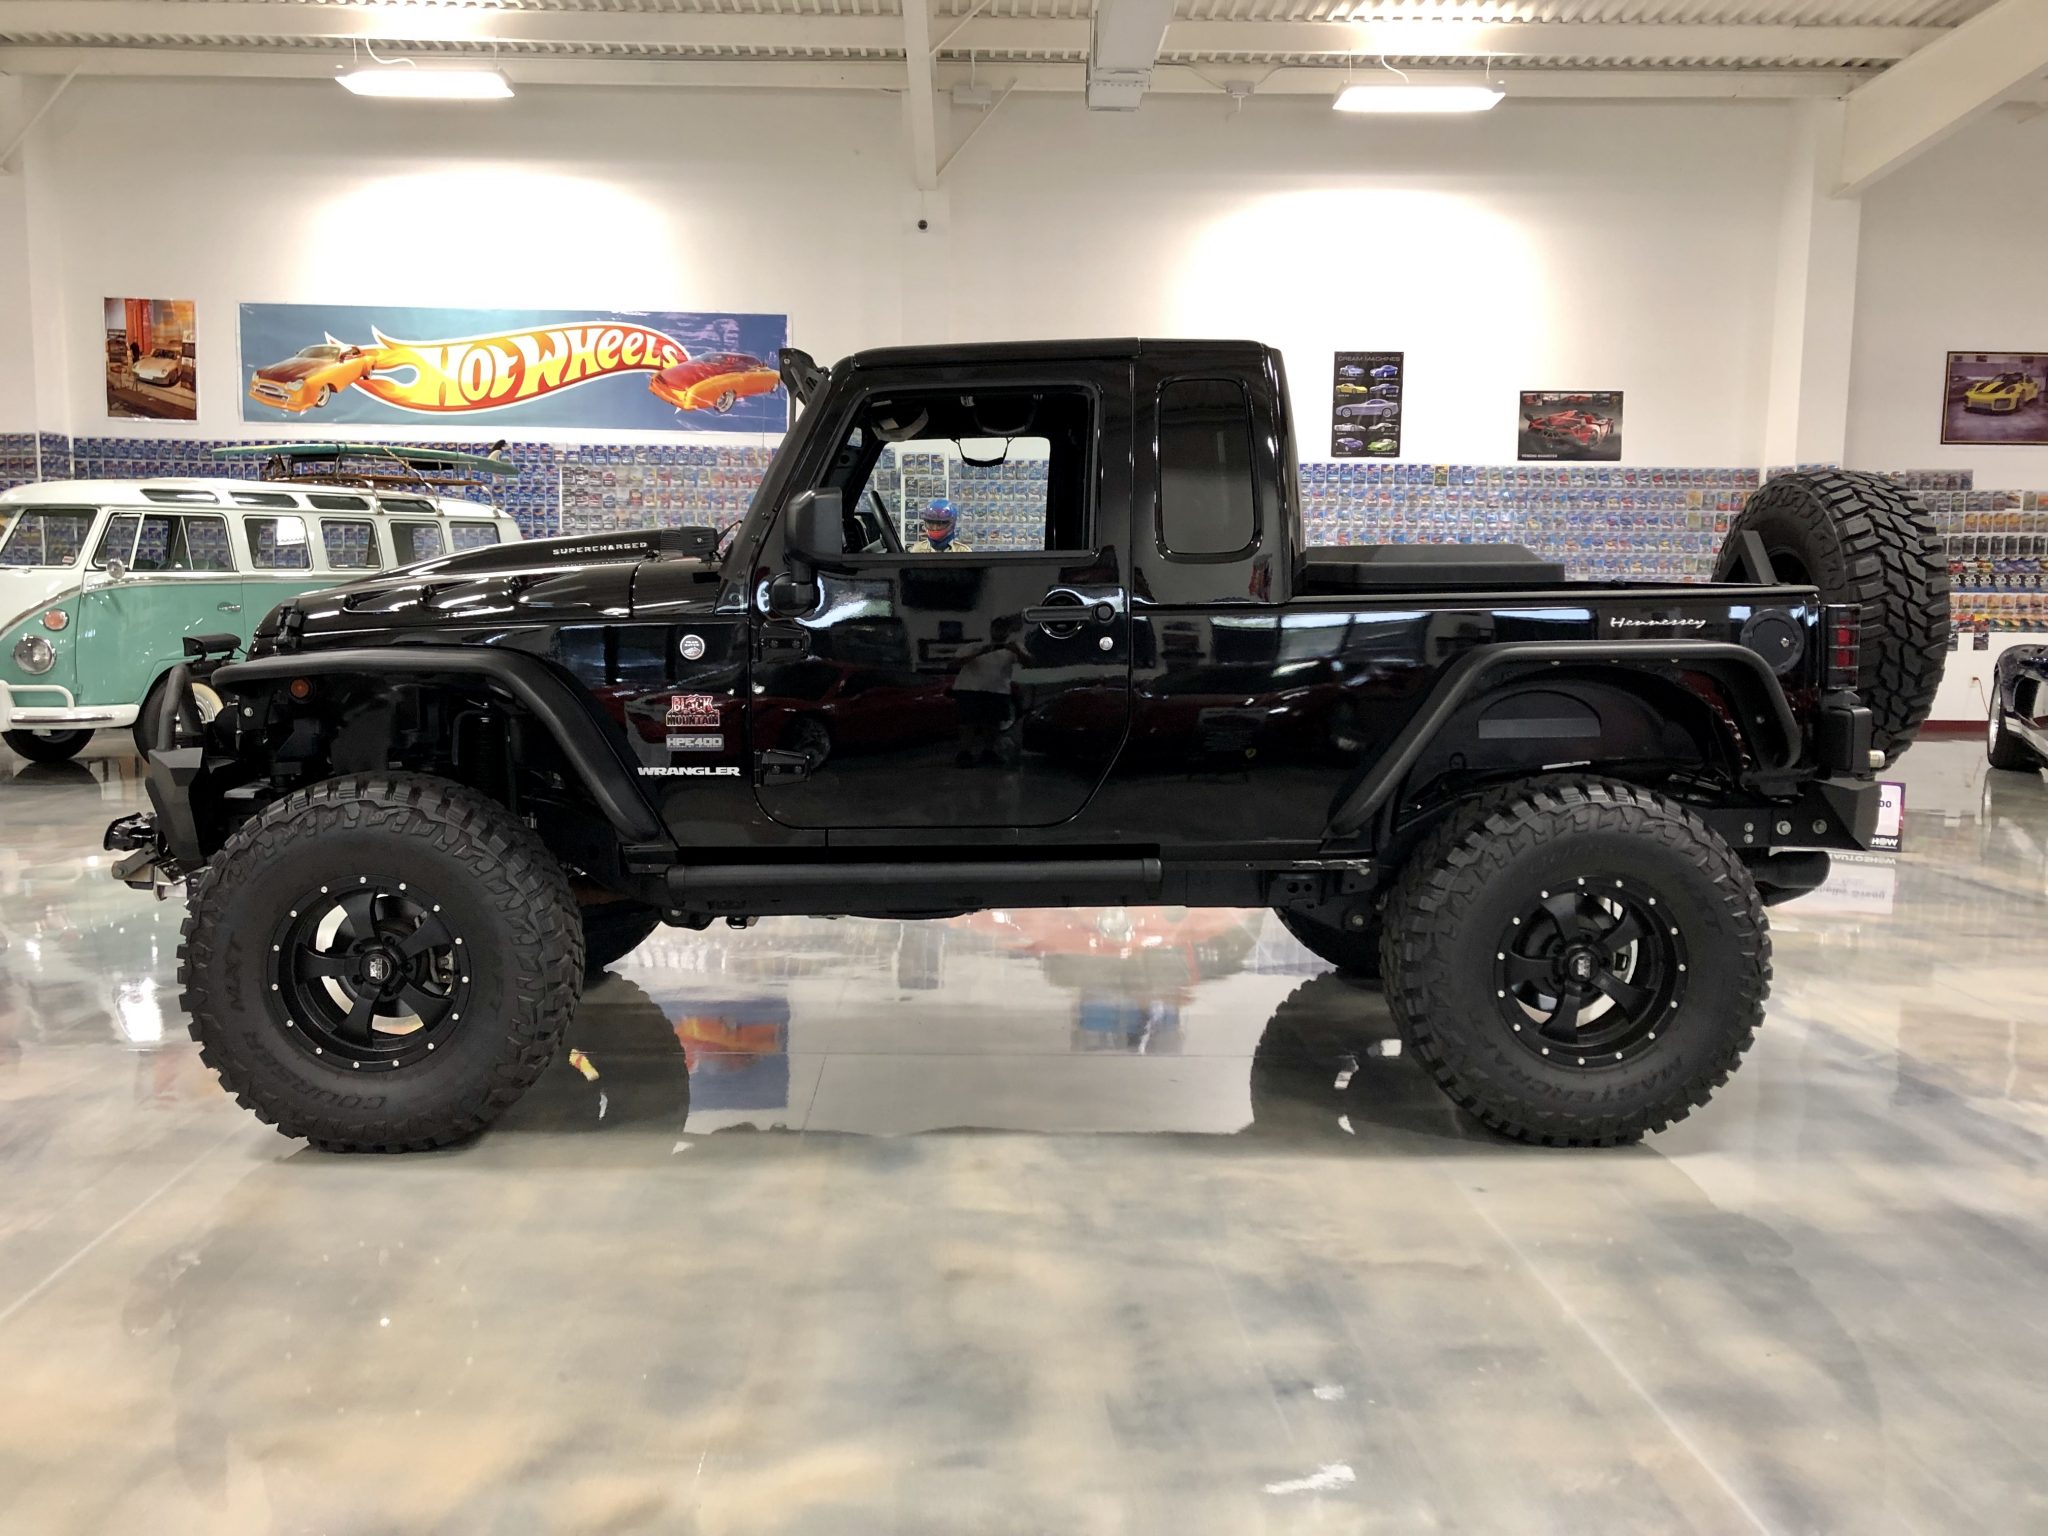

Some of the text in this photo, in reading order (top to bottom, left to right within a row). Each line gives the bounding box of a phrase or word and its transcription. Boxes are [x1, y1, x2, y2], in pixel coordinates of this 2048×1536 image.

[552, 541, 648, 555] SUPERCHARGED
[1610, 617, 1706, 629] Hennessey
[667, 714, 719, 725] MOUNTAIN
[666, 737, 722, 747] HPE400
[637, 766, 741, 776] WRANGLER
